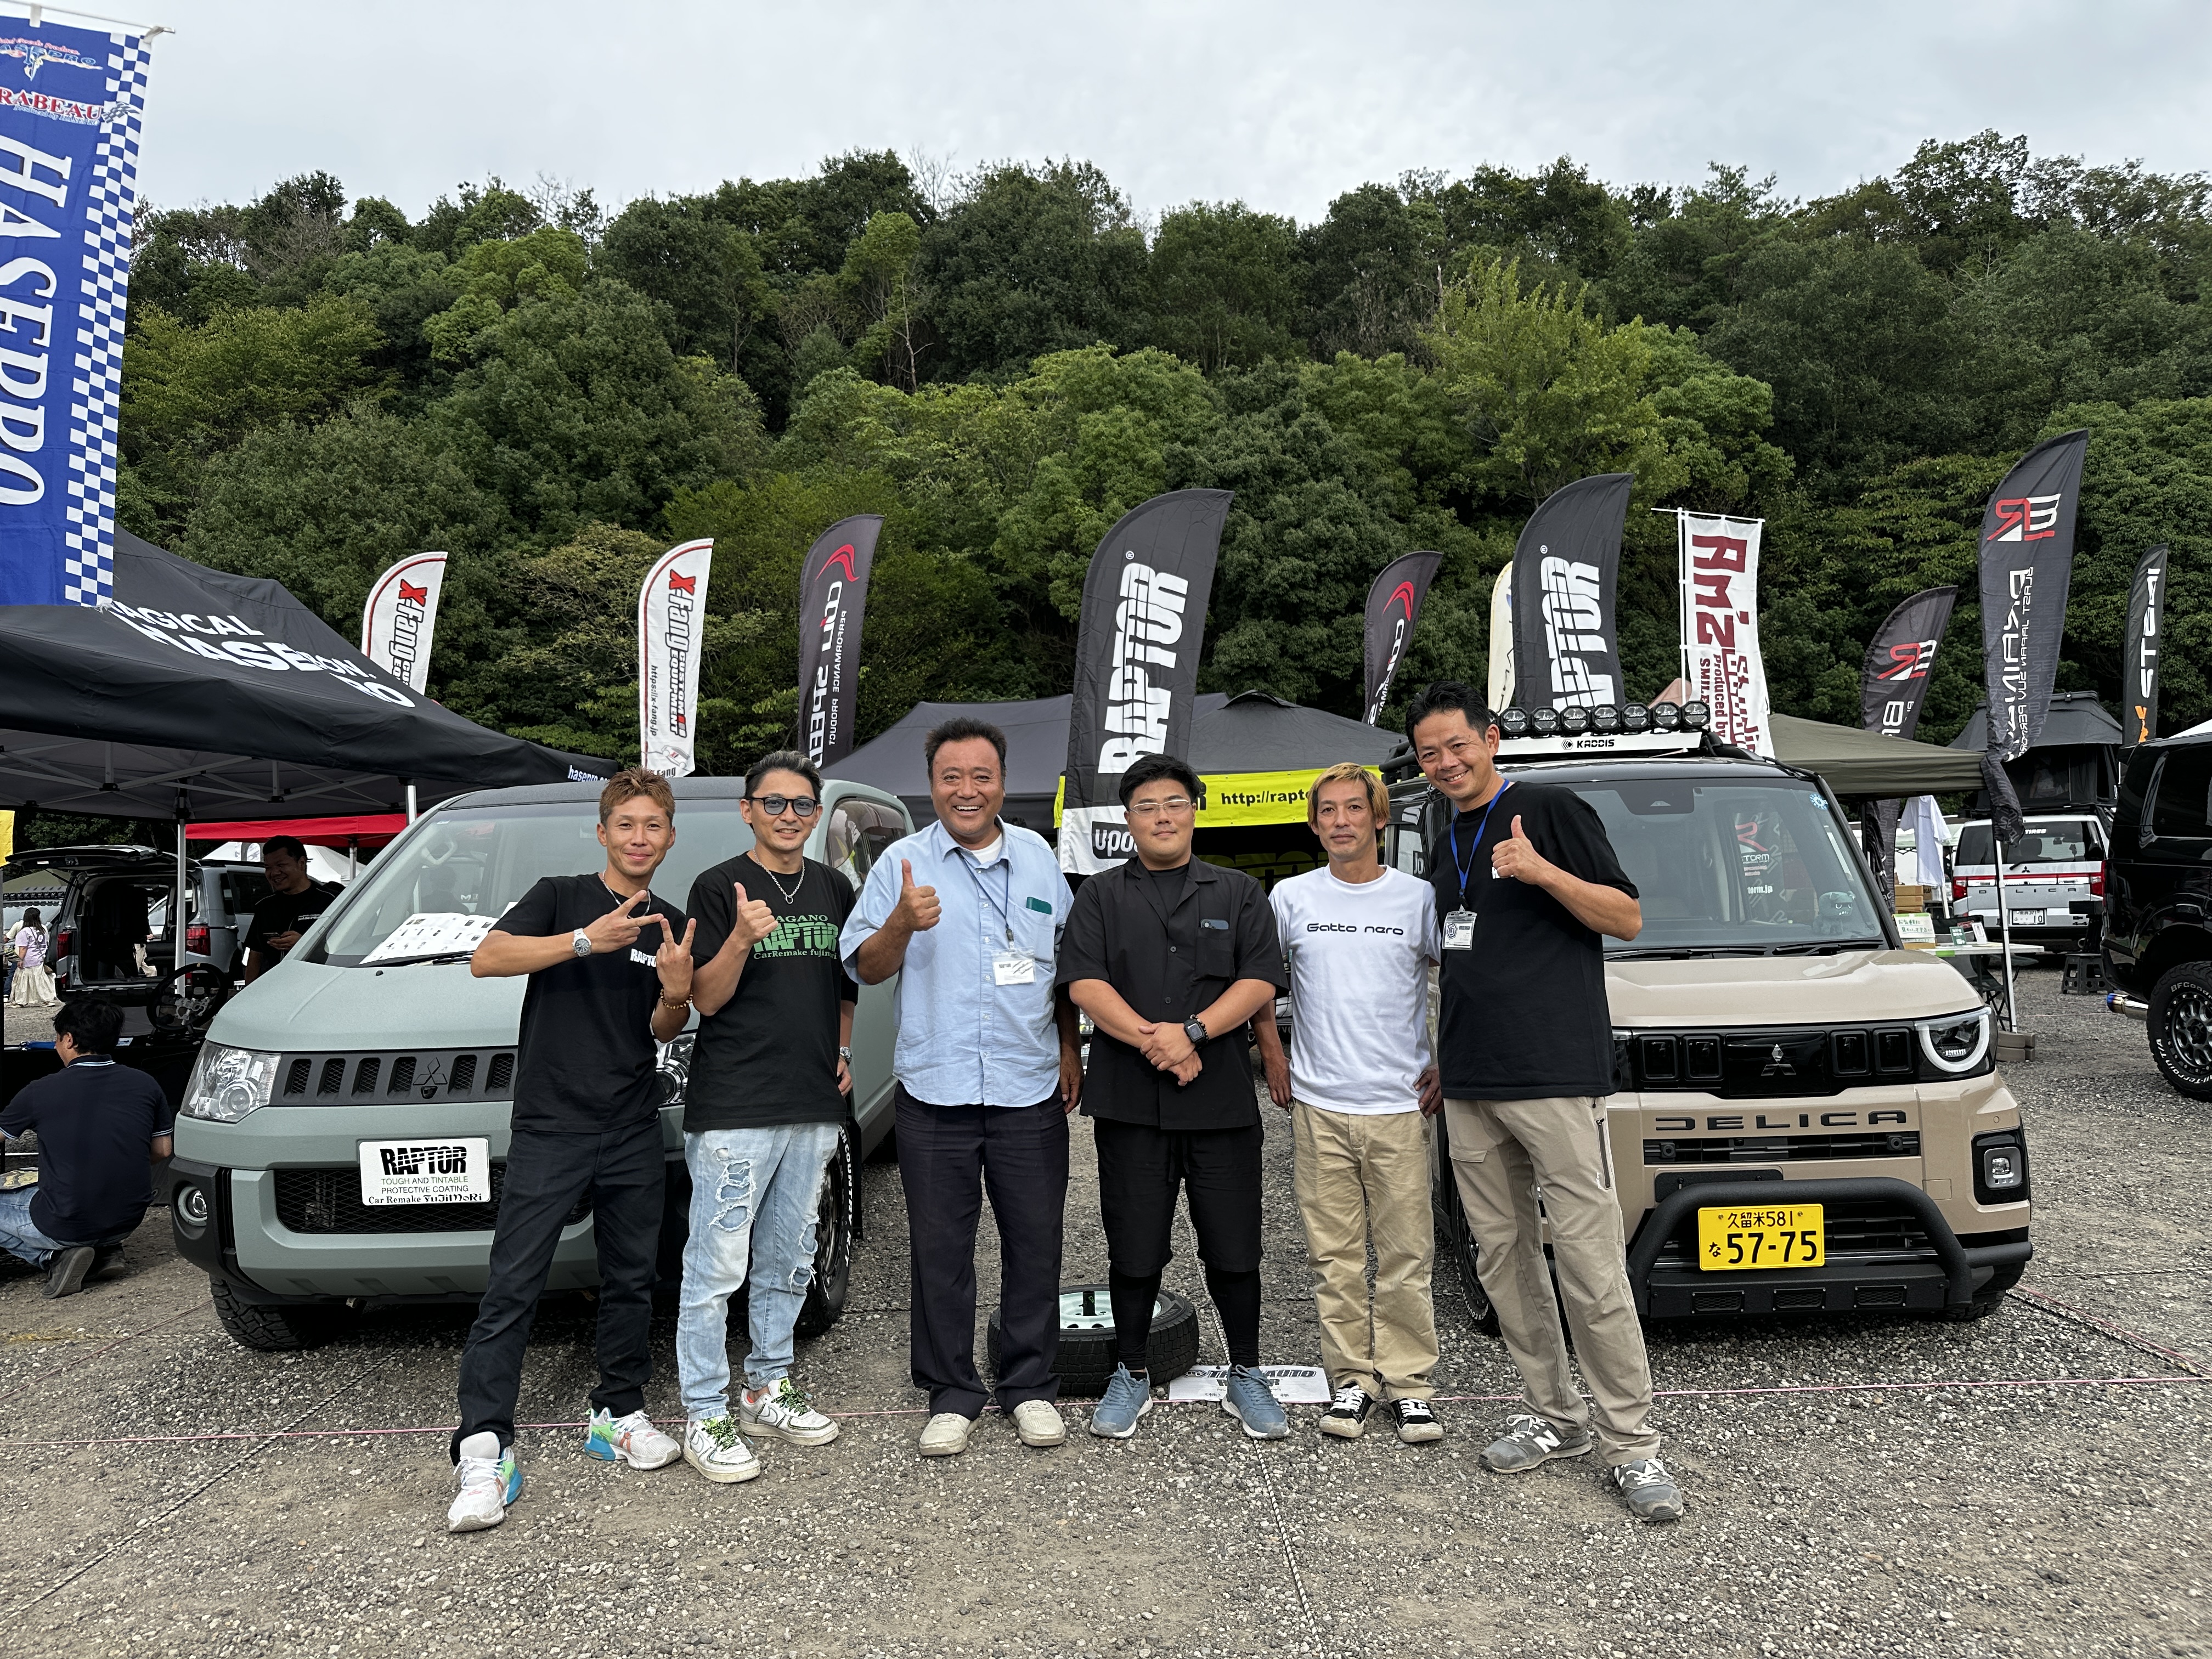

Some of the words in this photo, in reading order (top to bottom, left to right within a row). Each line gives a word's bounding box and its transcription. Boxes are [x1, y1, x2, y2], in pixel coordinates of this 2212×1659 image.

[389, 579, 427, 662] X-Fang
[665, 569, 696, 652] X-Fang
[669, 648, 679, 737] EQUIPMENT
[677, 651, 686, 715] CUSTOM
[1577, 739, 1615, 748] KADDIS
[1747, 884, 1773, 894] torm.jp
[1307, 923, 1357, 933] Gatto
[1364, 926, 1404, 935] nero
[630, 948, 657, 967] RAPTO
[1655, 1110, 1906, 1131] DELICA
[380, 1146, 467, 1175] RAPTOR
[381, 1186, 430, 1194] PROTECTIVE
[386, 1195, 421, 1204] Remake
[1708, 1241, 1722, 1257] な
[1726, 1231, 1817, 1264] 57-75
